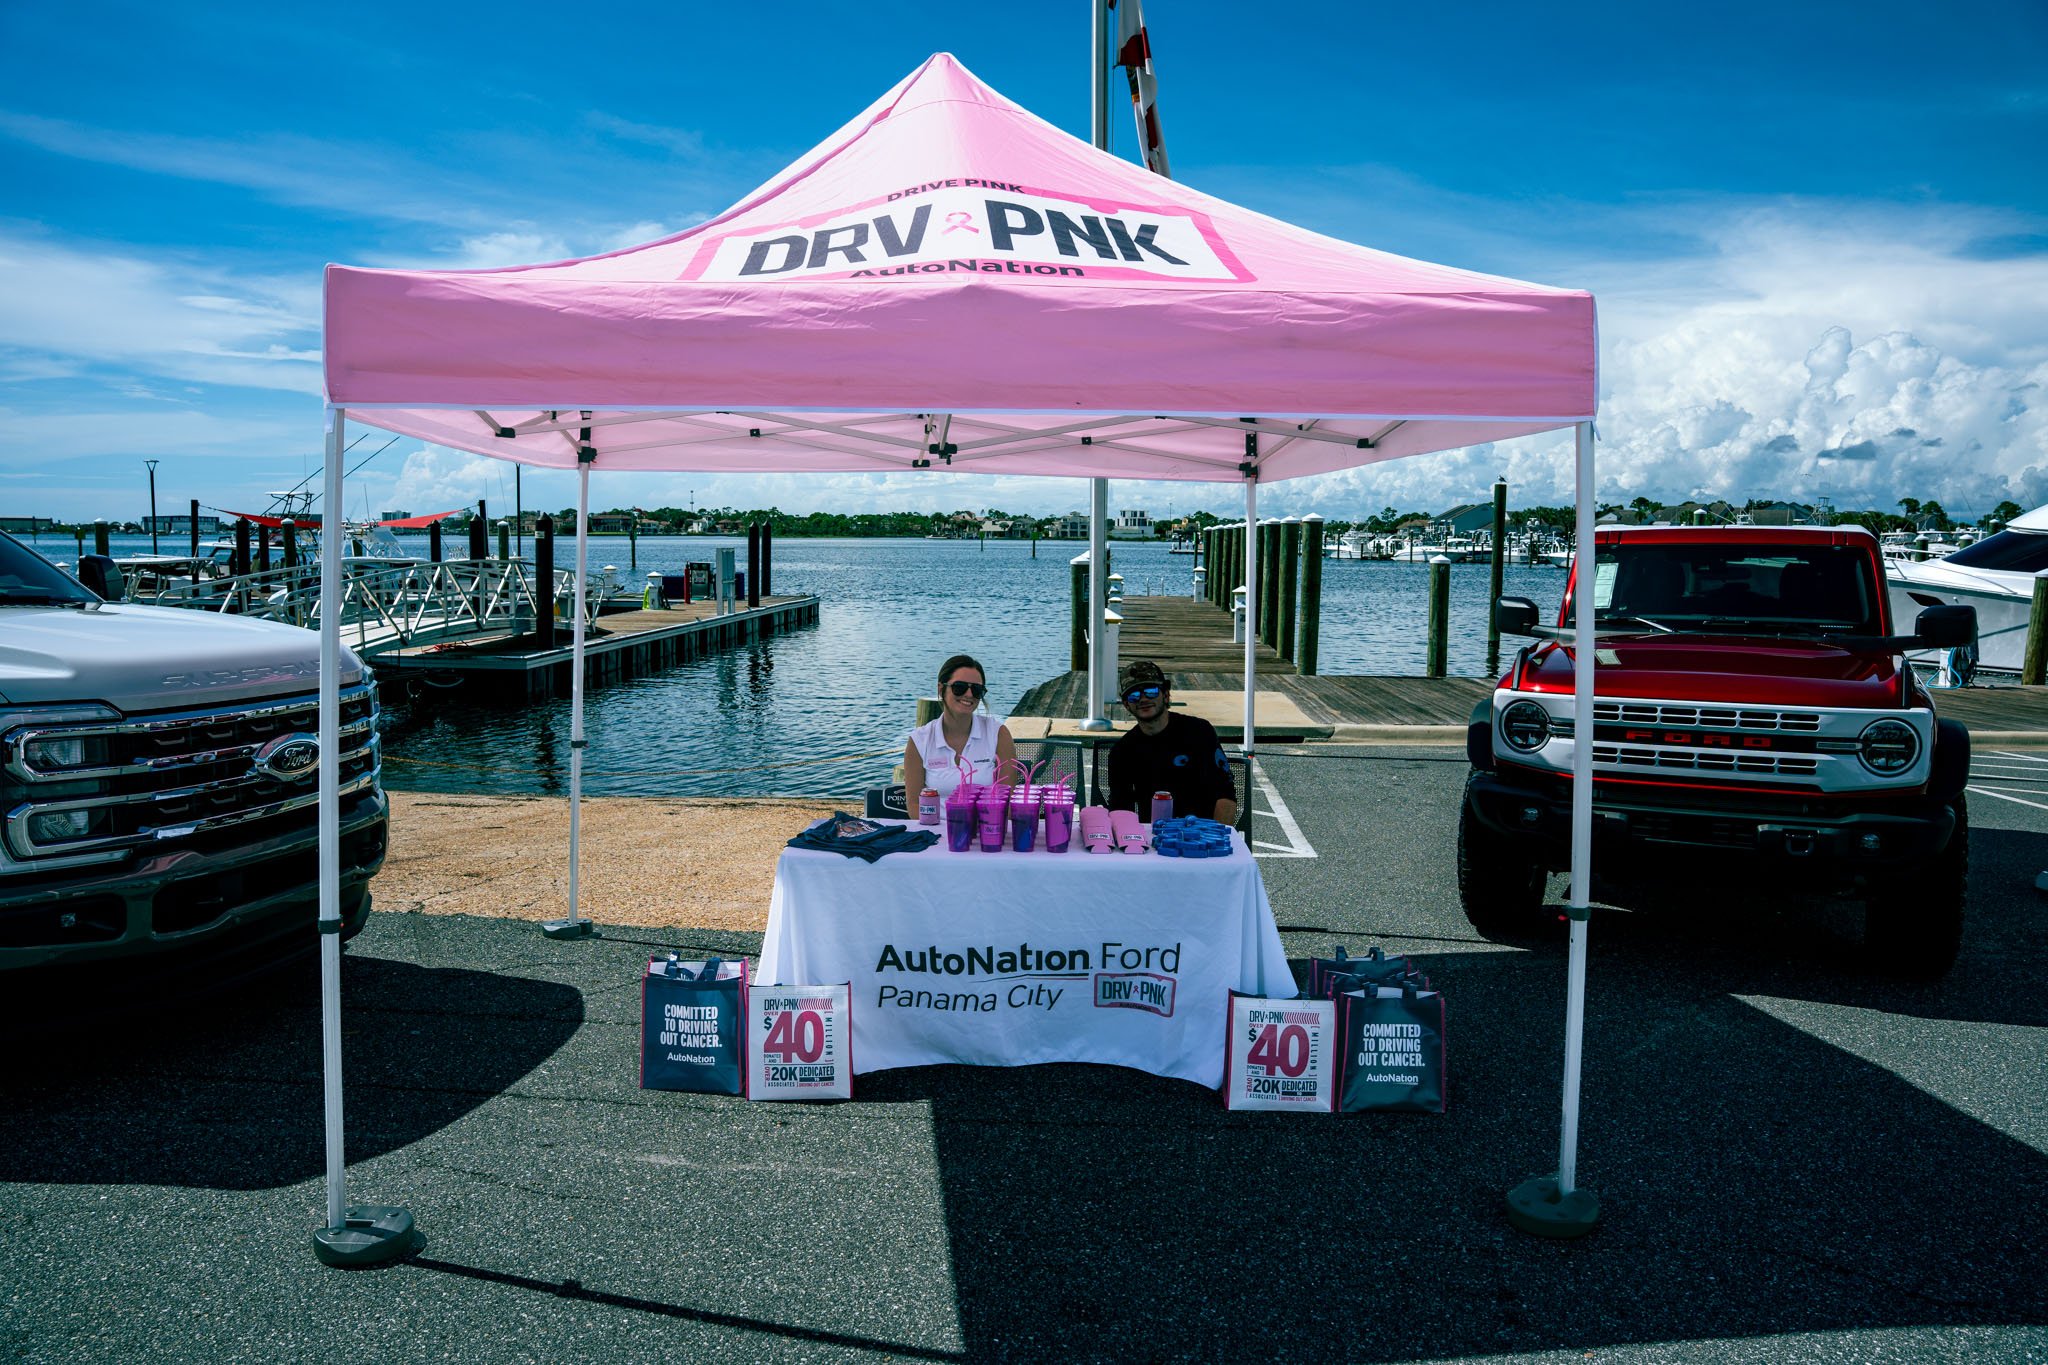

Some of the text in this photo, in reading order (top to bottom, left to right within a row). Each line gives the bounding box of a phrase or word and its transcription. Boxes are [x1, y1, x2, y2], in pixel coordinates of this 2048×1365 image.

[887, 178, 1025, 202] DRIVE PINK
[738, 199, 1191, 277] DRV PNK
[849, 259, 1085, 279] AutoNation
[1626, 730, 1771, 747] FORD
[282, 745, 312, 770] Ford
[1101, 942, 1181, 974] Ford
[877, 984, 1064, 1012] Panama City
[1102, 981, 1132, 1000] DRV
[1140, 981, 1167, 1007] PNK
[664, 1003, 719, 1020] COMMITTED
[764, 998, 799, 1011] DRV PNK
[1249, 1010, 1285, 1024] DRV PNK
[664, 1018, 718, 1034] TO DRIVING
[1363, 1023, 1421, 1038] COMMITTED
[660, 1031, 723, 1048] OUT CANCER.
[825, 1017, 833, 1056] MILLION
[1363, 1037, 1421, 1052] TO DRIVING
[667, 1052, 716, 1064] AutoNation
[1310, 1032, 1319, 1070] MILLION
[1358, 1052, 1426, 1067] OUT CANCER.
[771, 1065, 835, 1081] 20K DEDICATED
[1366, 1073, 1419, 1083] AutoNation
[1253, 1078, 1317, 1094] 20K DEDICATED
